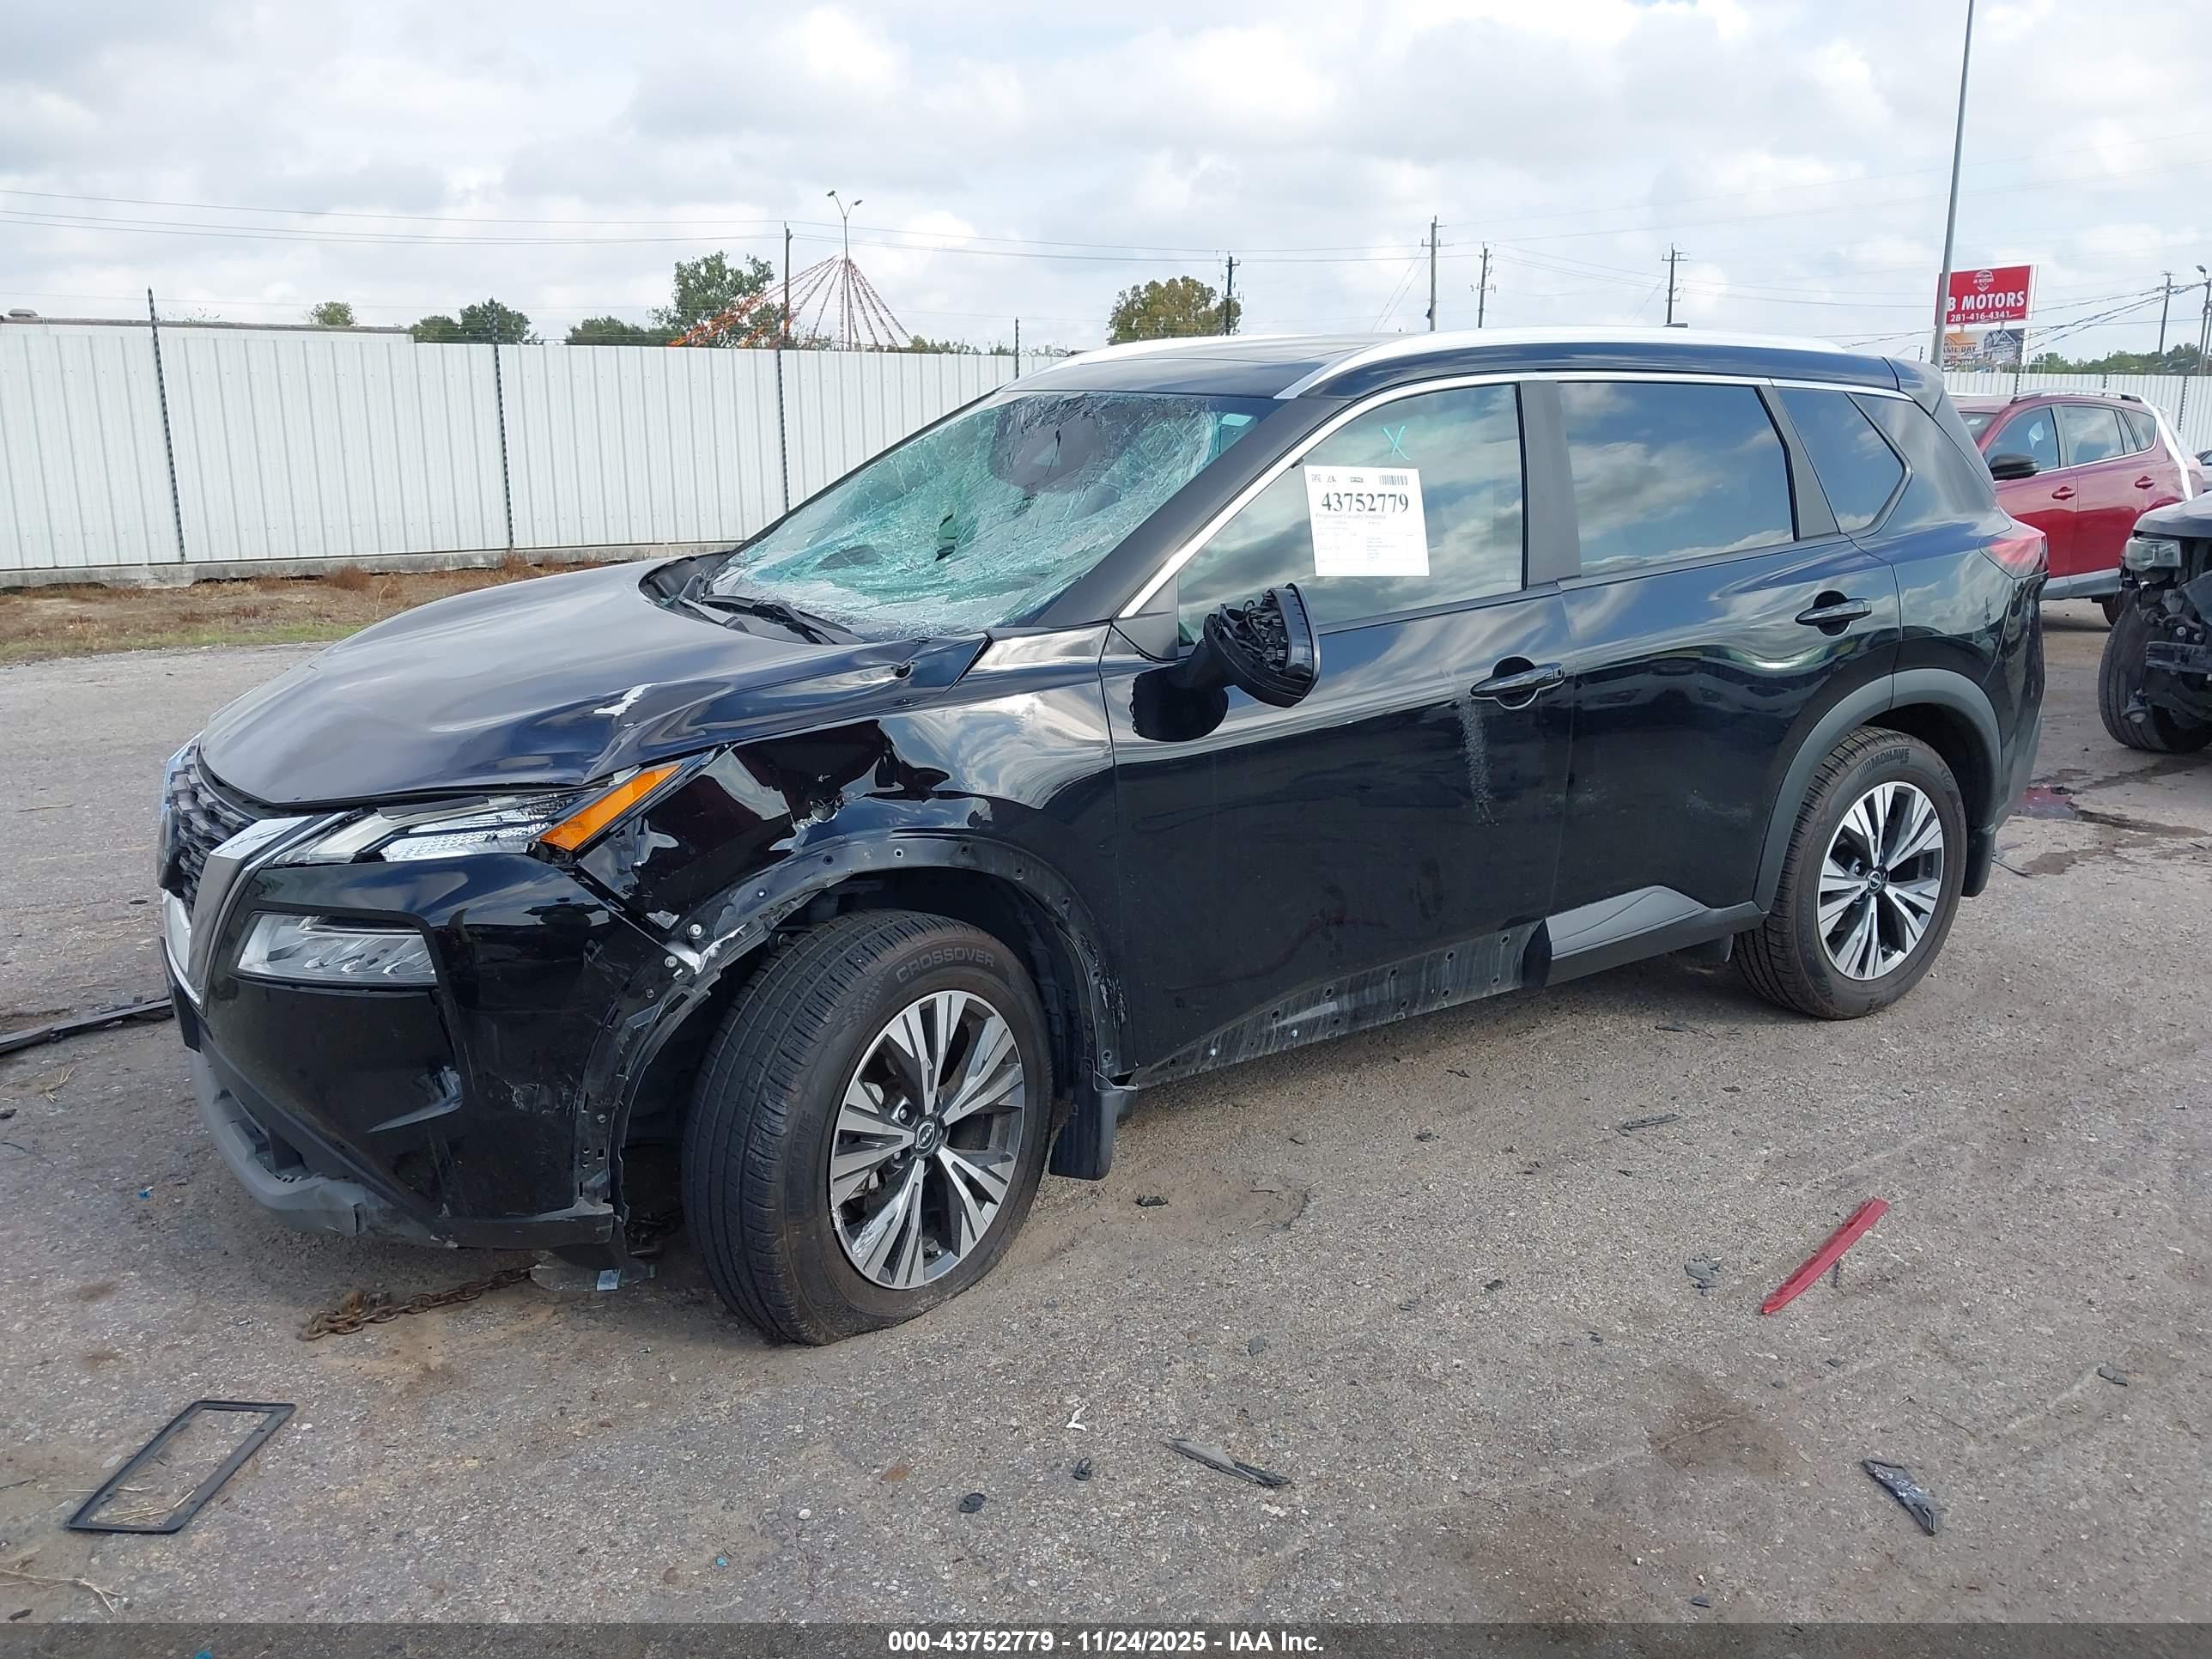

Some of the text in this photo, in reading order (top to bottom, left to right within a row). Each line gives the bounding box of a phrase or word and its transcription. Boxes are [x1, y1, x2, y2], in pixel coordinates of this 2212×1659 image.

[1948, 291, 2025, 313] B MOTORS
[1950, 311, 2009, 323] 281-416-4341
[1321, 492, 1409, 514] 43752779
[896, 946, 995, 983] CROSSOVER
